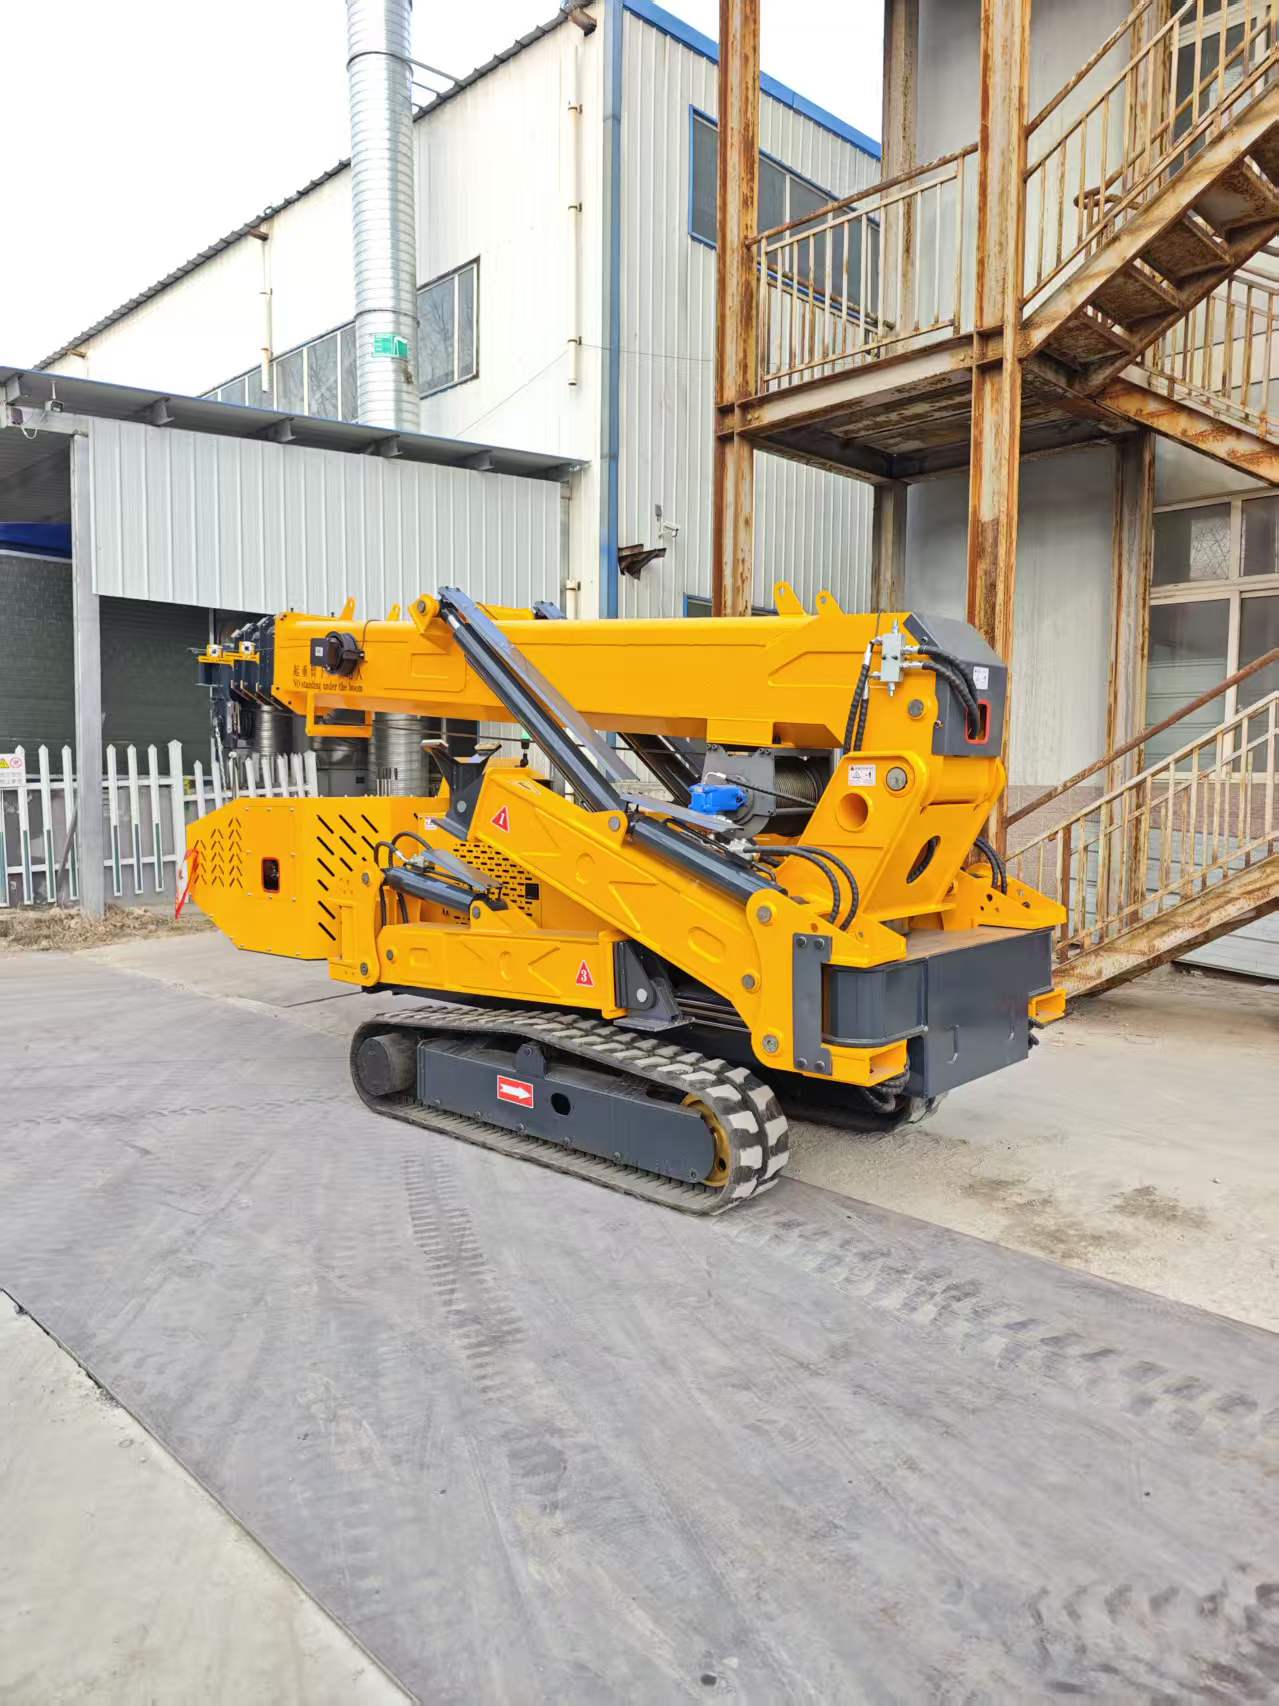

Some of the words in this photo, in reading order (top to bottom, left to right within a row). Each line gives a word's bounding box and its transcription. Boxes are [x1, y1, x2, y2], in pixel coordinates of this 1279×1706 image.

[302, 681, 321, 691] standing
[323, 682, 338, 691] under
[339, 682, 348, 691] the
[349, 682, 363, 692] boom
[580, 969, 588, 983] 3
